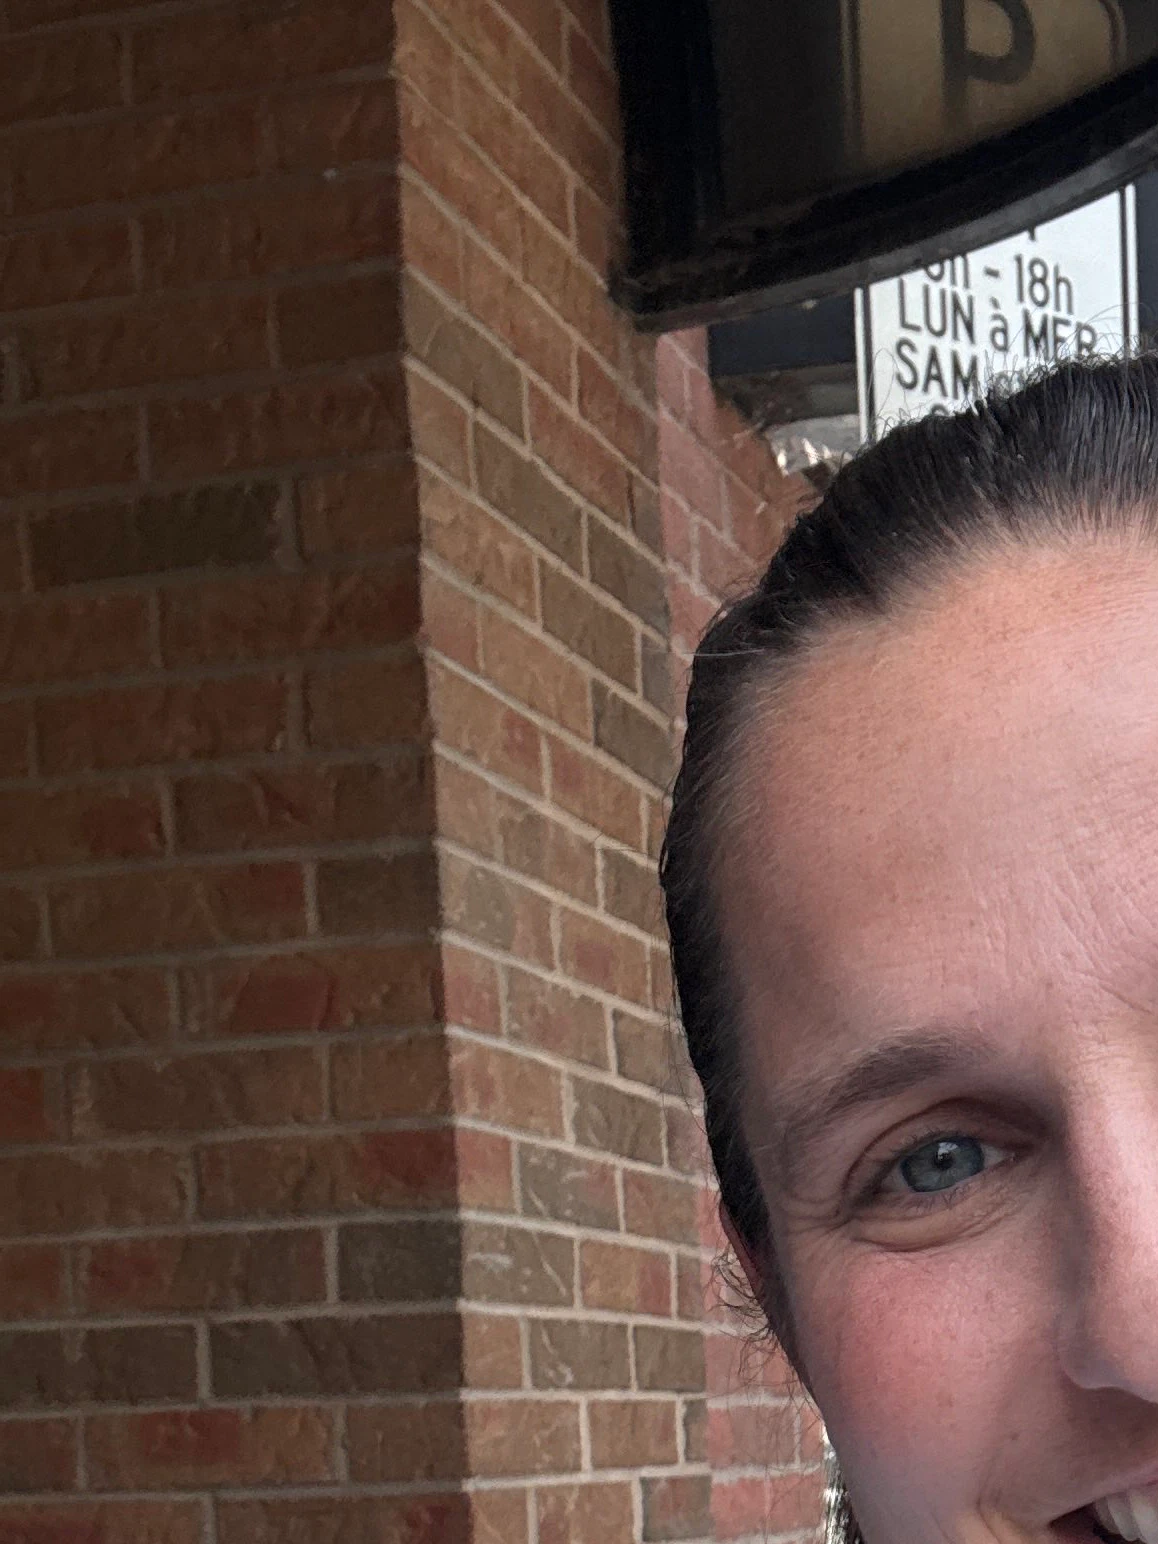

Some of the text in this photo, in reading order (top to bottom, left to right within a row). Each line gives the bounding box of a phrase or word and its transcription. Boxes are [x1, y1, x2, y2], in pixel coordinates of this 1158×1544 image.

[898, 277, 977, 345] LUN
[990, 296, 1009, 352] à
[1014, 253, 1074, 315] 18h
[894, 336, 979, 400] SAM
